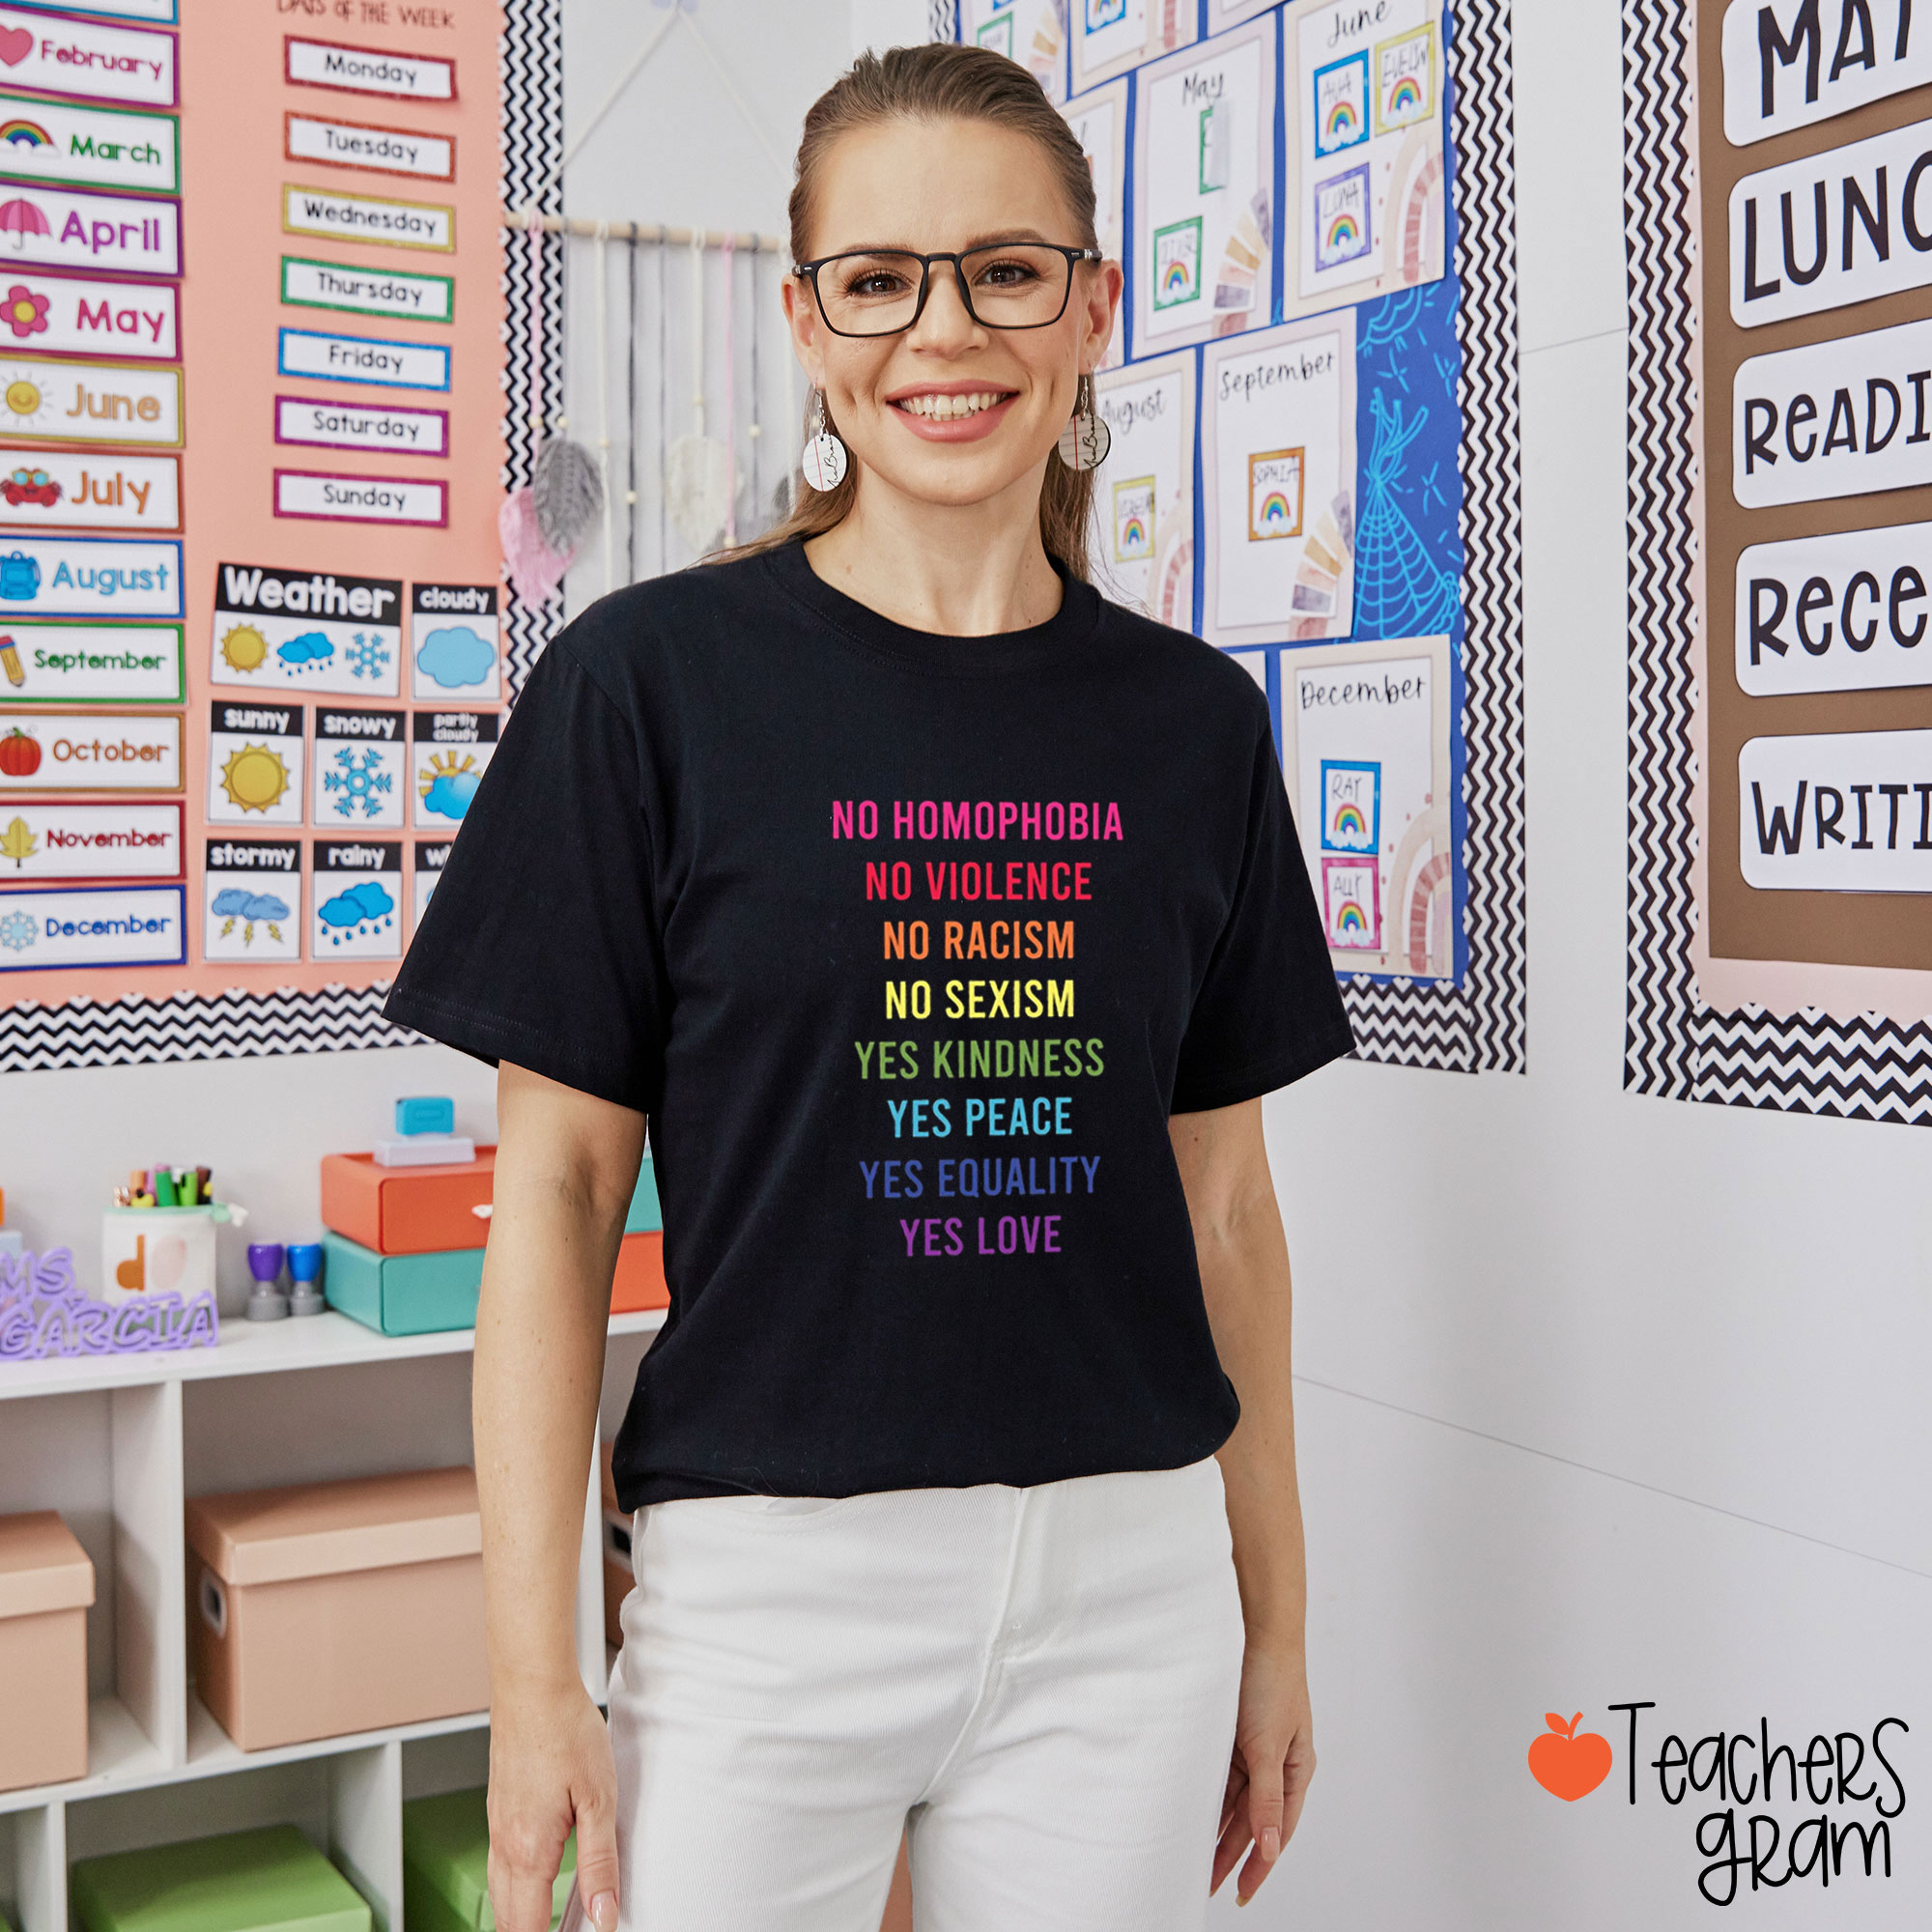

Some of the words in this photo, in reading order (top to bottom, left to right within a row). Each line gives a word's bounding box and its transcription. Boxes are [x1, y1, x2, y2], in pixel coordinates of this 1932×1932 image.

[333, 0, 355, 21] OF
[360, 1, 388, 24] THE
[398, 7, 456, 28] WEEK
[1327, 1, 1390, 47] June
[42, 40, 162, 80] February
[325, 55, 417, 86] Monday
[1182, 72, 1223, 104] May
[71, 134, 160, 164] March
[325, 129, 418, 162] Tuesday
[60, 211, 160, 254] April
[305, 201, 437, 237] Wednesday
[318, 272, 423, 307] Thursday
[77, 298, 164, 343] May
[329, 345, 404, 374] Friday
[1219, 352, 1334, 402] September
[67, 384, 161, 421] June
[1101, 389, 1167, 435] August
[313, 412, 420, 440] Saturday
[71, 471, 151, 515] July
[324, 484, 407, 511] Sunday
[52, 561, 169, 594] August
[225, 566, 395, 618] Weather
[418, 588, 490, 612] cloudy
[35, 649, 166, 673] September
[1300, 674, 1426, 710] December
[224, 706, 291, 735] sunny
[324, 713, 397, 737] snowy
[434, 713, 478, 728] partly
[434, 727, 479, 743] cloudy
[53, 739, 168, 762] October
[1331, 774, 1363, 802] RAY
[833, 801, 878, 840] NO
[895, 801, 1123, 840] HOMOPHOBIA
[1751, 781, 1932, 855] WRITI
[46, 829, 171, 848] November
[211, 843, 296, 868] stormy
[328, 843, 385, 868] rainy
[867, 862, 912, 900] NO
[925, 862, 1093, 900] VIOLENCE
[45, 915, 171, 937] December
[884, 921, 929, 959] NO
[945, 921, 1074, 959] RACISM
[886, 980, 931, 1019] NO
[946, 980, 1074, 1018] SEXISM
[855, 1040, 919, 1079] YES
[934, 1038, 1104, 1078] KINDNESS
[888, 1098, 952, 1138] YES
[966, 1097, 1072, 1136] PEACE
[860, 1159, 923, 1199] YES
[939, 1156, 1100, 1198] EQUALITY
[900, 1218, 963, 1257] YES
[979, 1215, 1061, 1254] LOVE
[0, 1290, 219, 1360] GARCIA
